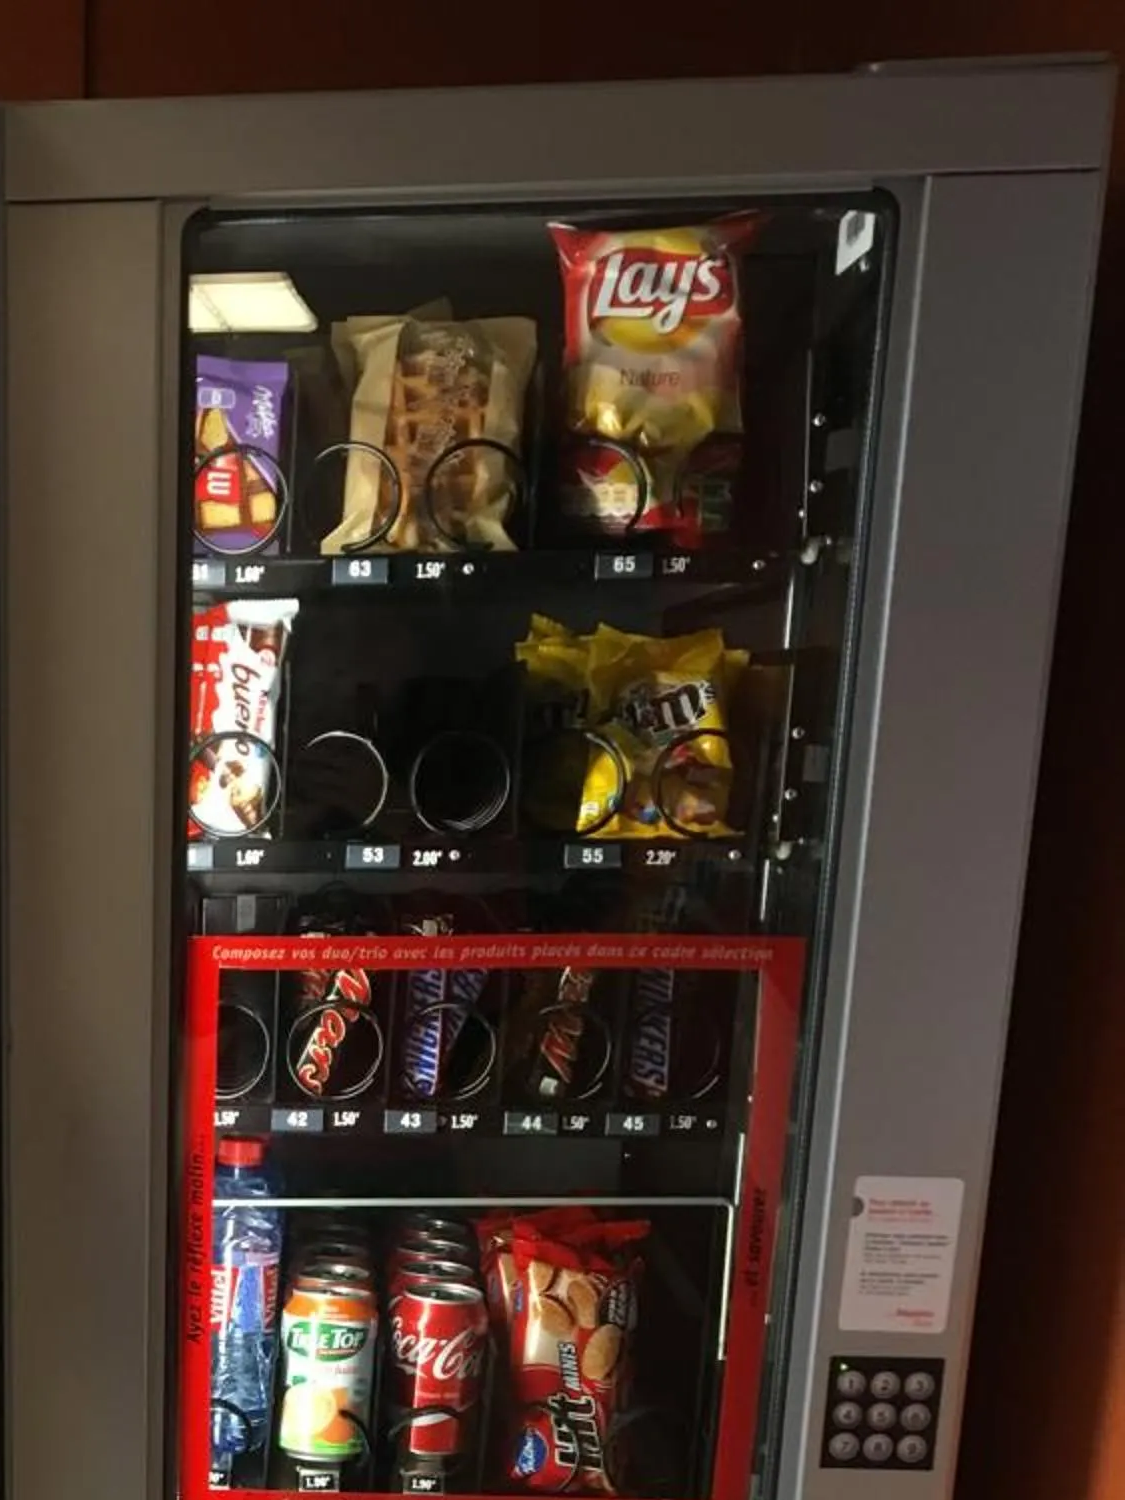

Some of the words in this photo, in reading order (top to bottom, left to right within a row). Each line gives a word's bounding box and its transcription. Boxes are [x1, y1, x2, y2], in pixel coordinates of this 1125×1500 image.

[592, 252, 723, 335] Lay's
[621, 368, 680, 386] Nature
[349, 560, 371, 577] 63
[613, 556, 635, 573] 65
[231, 662, 261, 756] bueno
[362, 847, 383, 863] 53
[582, 848, 603, 863] 55
[212, 945, 285, 961] Composez
[291, 949, 315, 960] vos
[323, 946, 387, 962] duo/trio
[459, 945, 526, 961] produits
[287, 1112, 307, 1127] 42
[400, 1113, 421, 1128] 43
[522, 1115, 542, 1130] 44
[623, 1116, 644, 1130] 45
[557, 1343, 581, 1391] MINIS
